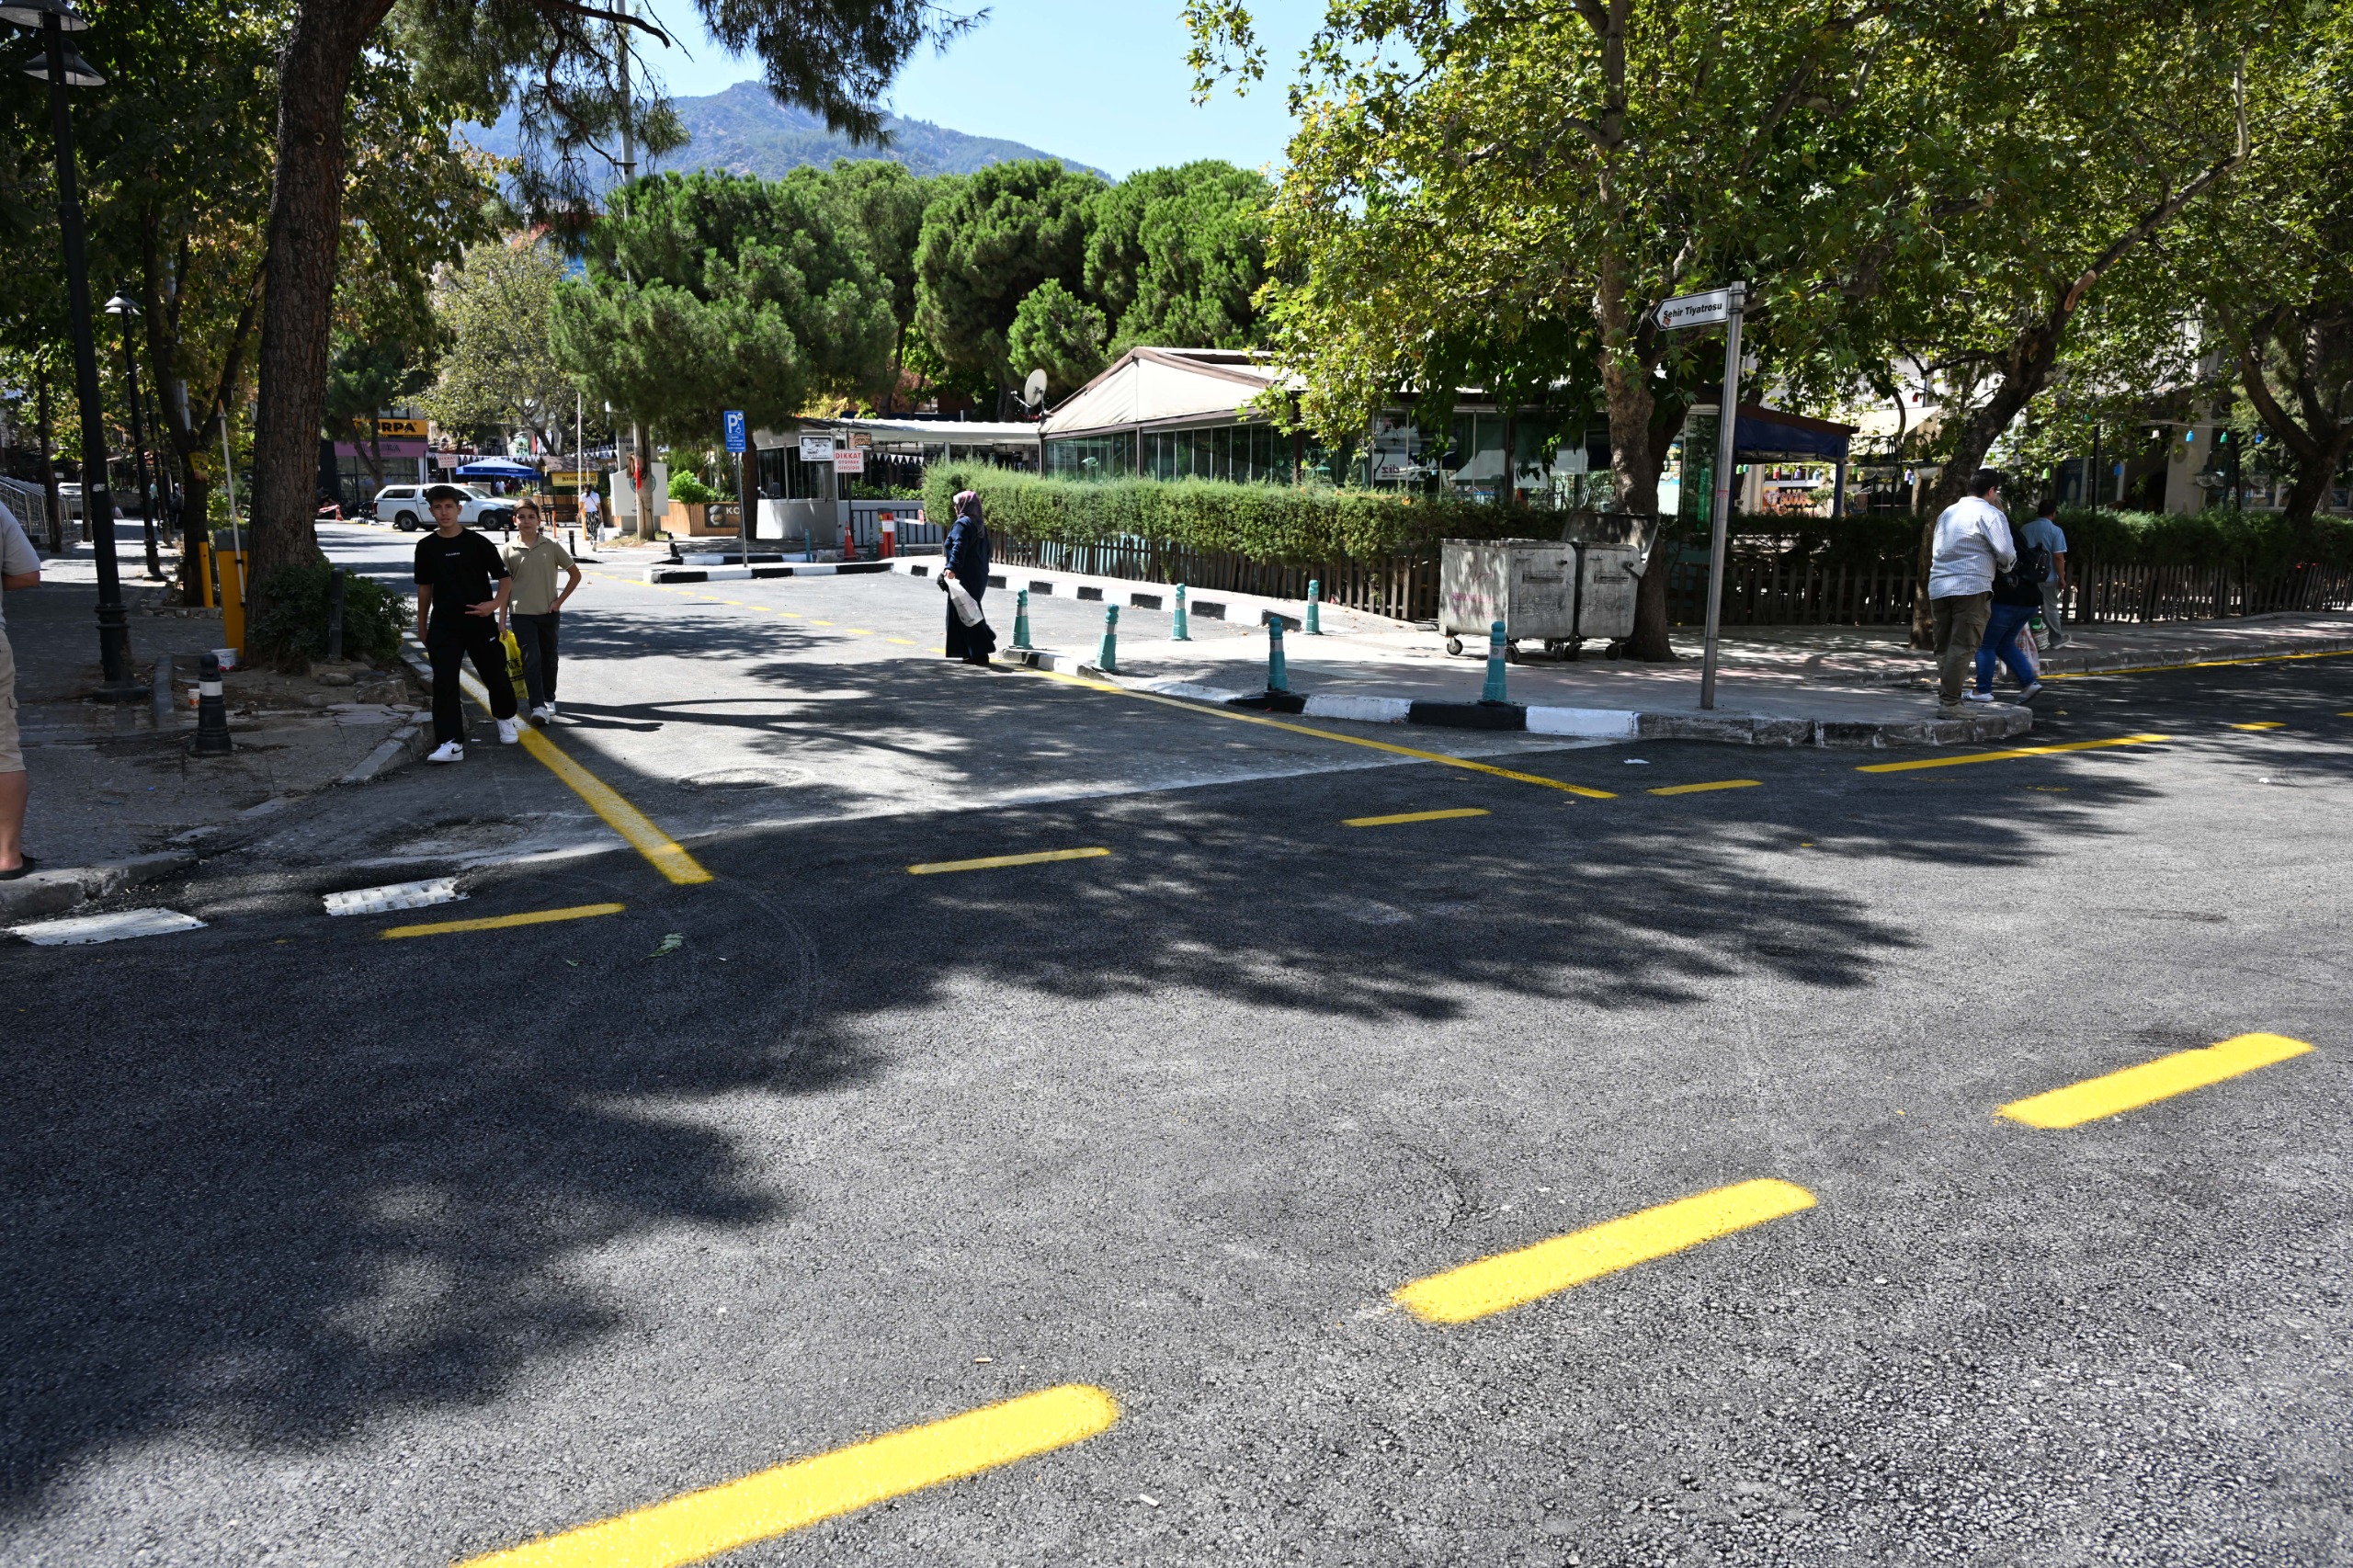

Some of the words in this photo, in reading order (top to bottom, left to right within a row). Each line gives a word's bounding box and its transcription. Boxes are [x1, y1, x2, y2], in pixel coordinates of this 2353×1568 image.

[1686, 302, 1722, 316] Tiyatrosu
[727, 414, 738, 434] P
[726, 506, 740, 515] KO
